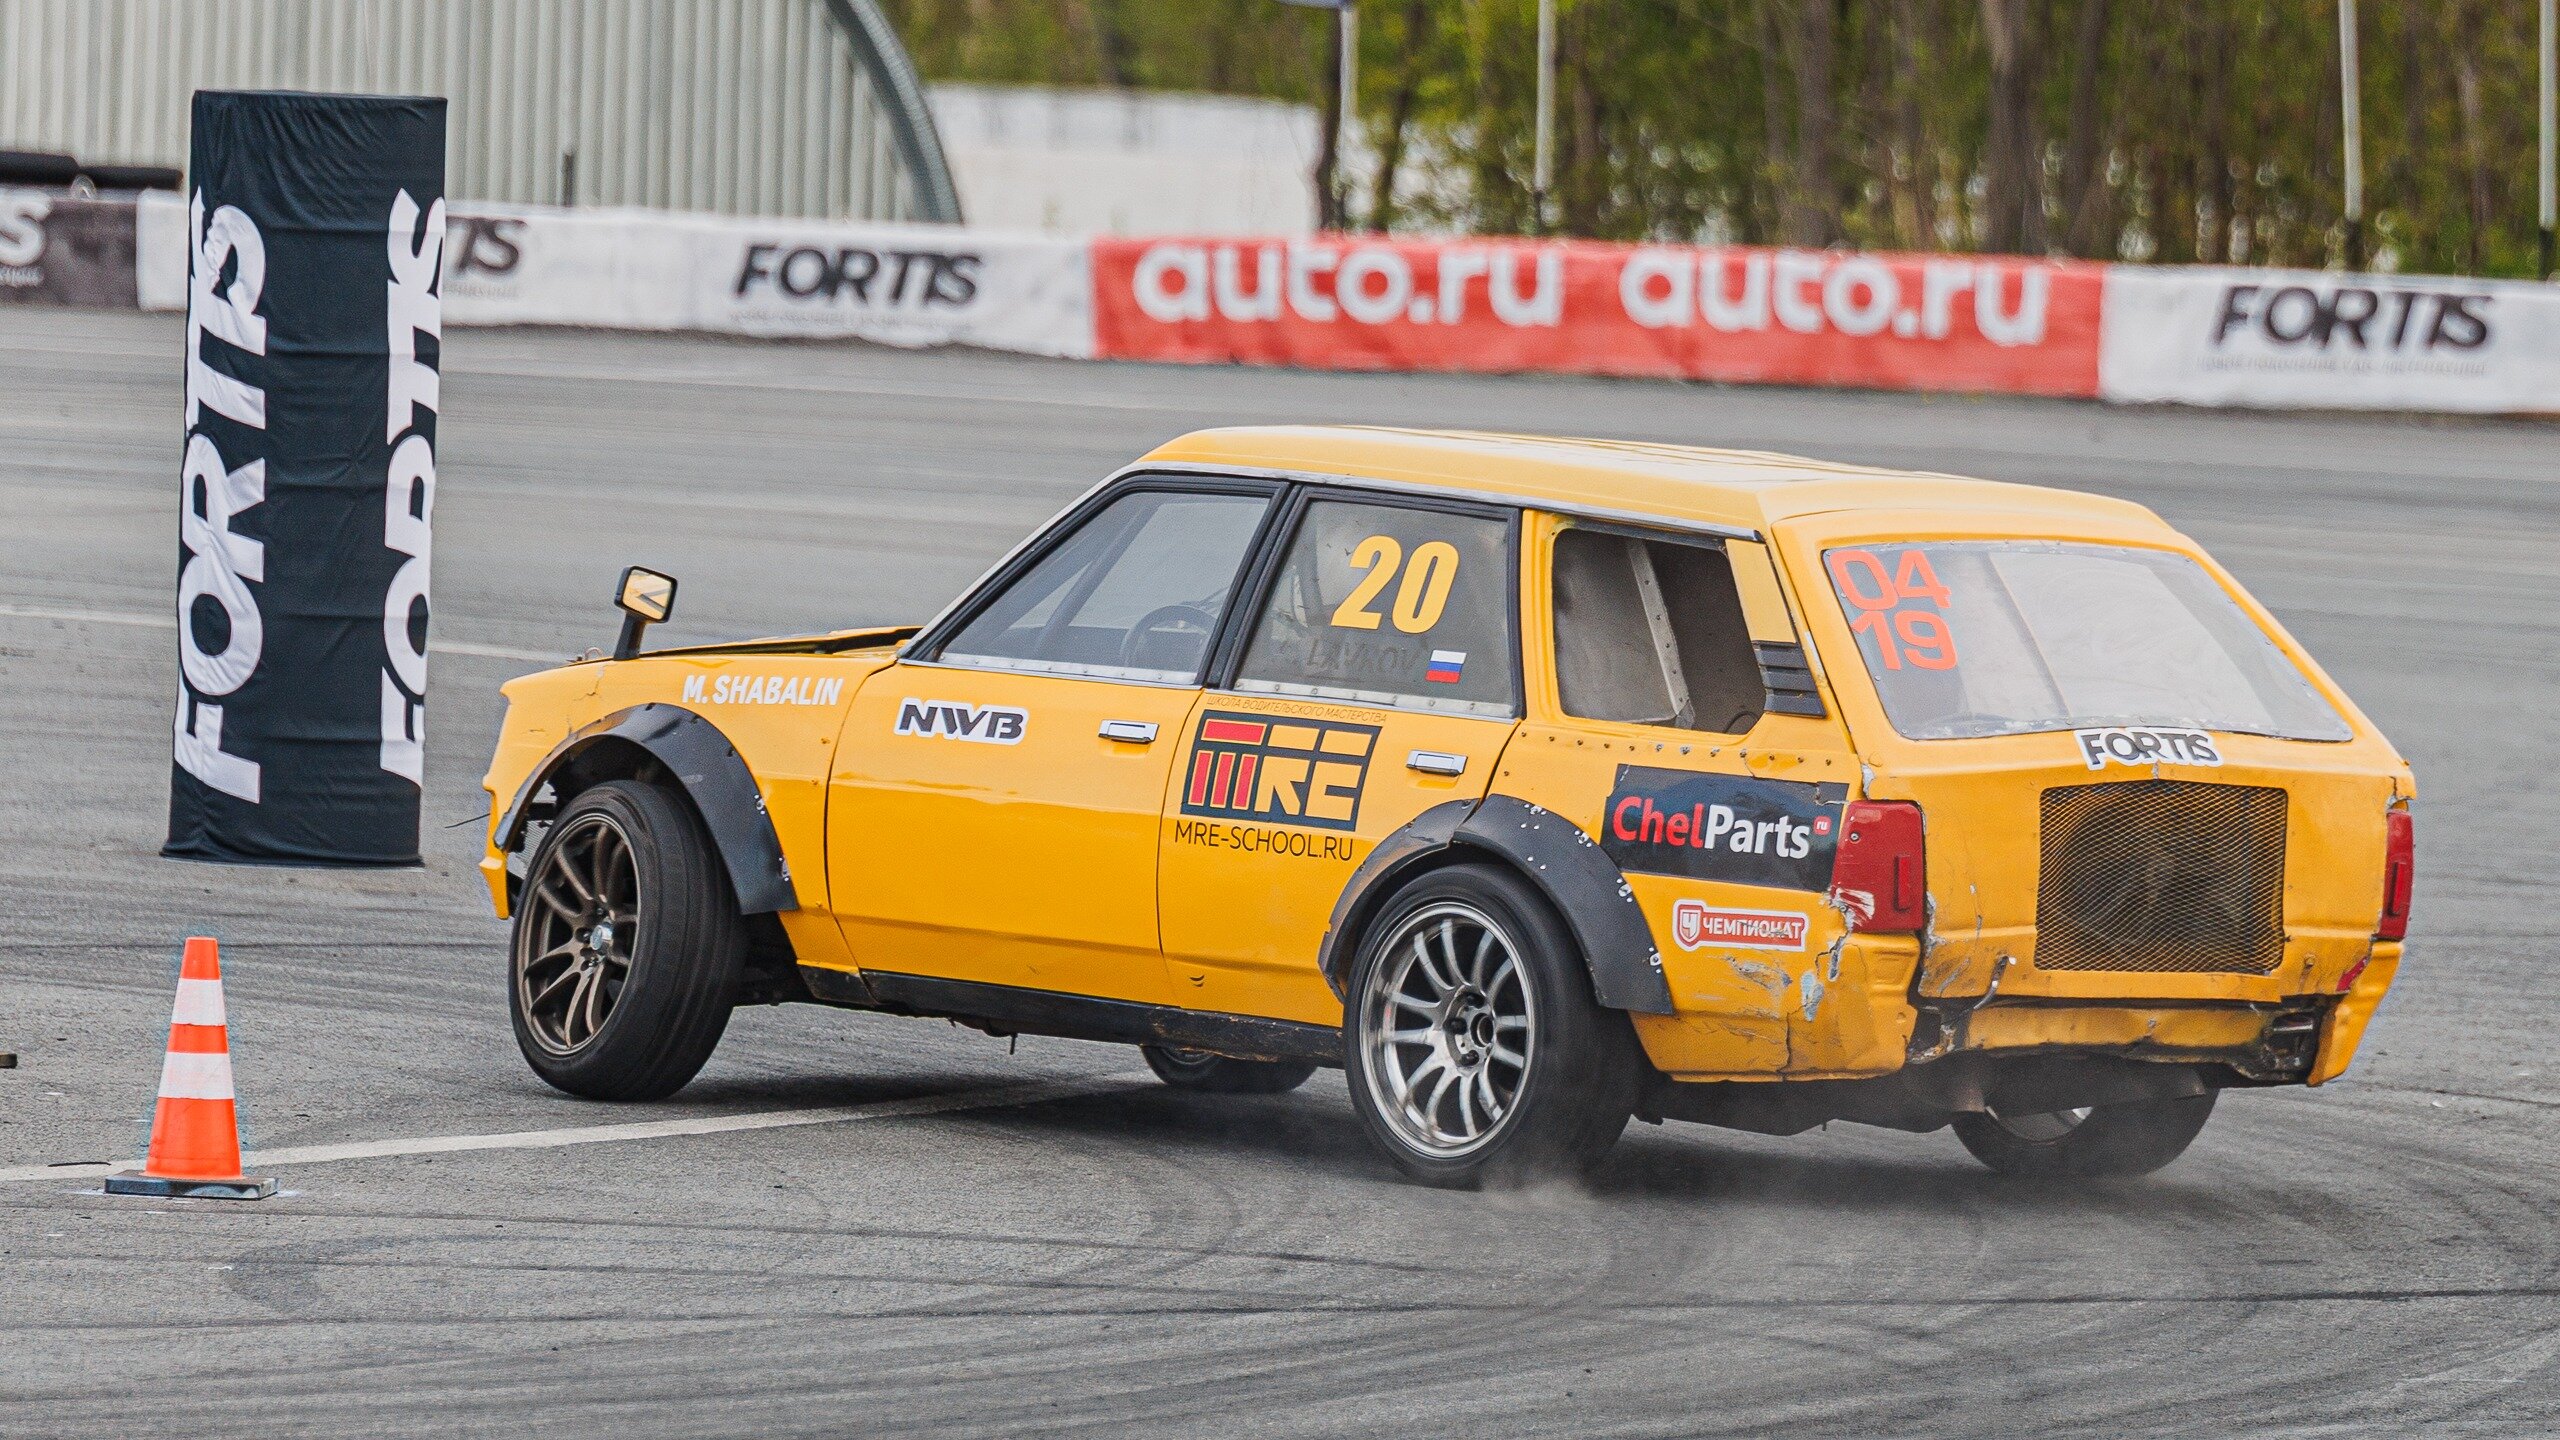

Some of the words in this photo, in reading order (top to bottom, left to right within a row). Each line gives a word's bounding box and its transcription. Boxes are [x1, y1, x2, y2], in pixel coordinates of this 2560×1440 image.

[736, 243, 981, 306] FORTIS
[1134, 245, 1564, 327] auto.ru
[1619, 247, 2047, 346] auto.ru
[2207, 284, 2495, 350] FORTIS
[174, 186, 266, 804] FORTIS
[1331, 534, 1461, 634] 20
[1829, 550, 1952, 611] 04
[1851, 611, 1959, 671] 19
[682, 675, 708, 704] M.
[712, 675, 844, 706] SHABALIN
[1206, 695, 1242, 708] ШКОЛА
[1242, 699, 1325, 717] ВОДИТЕЛЬСКОГО
[1324, 707, 1388, 723] МАСТЕРСТВА
[899, 703, 1025, 740] NWB
[2080, 731, 2219, 766] FORTIS
[1174, 819, 1354, 862] MRE-SCHOOL.RU
[1611, 795, 1811, 860] ChelParts
[1702, 916, 1803, 940] ЧЕМПИОНАТ
